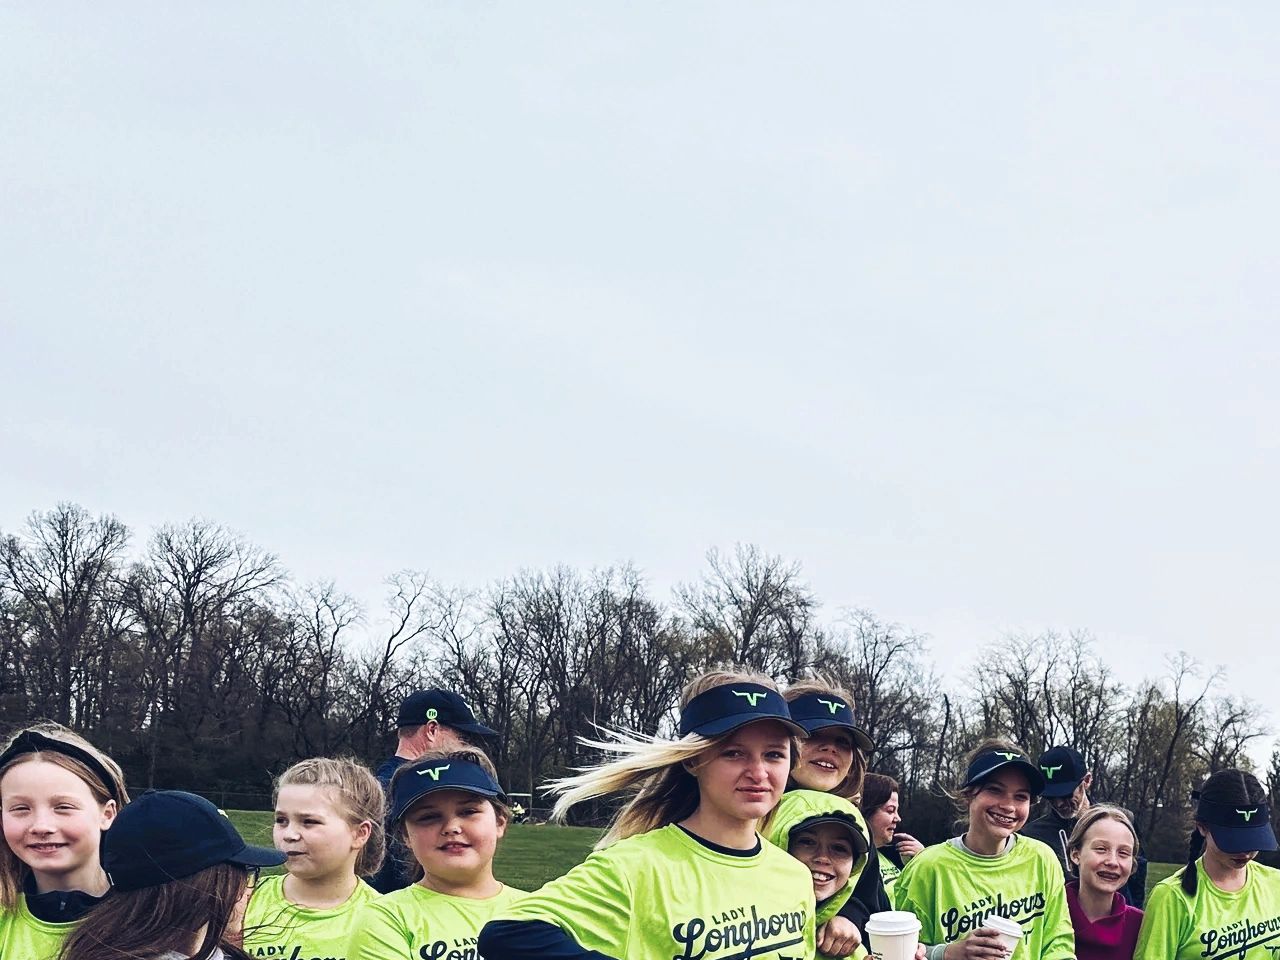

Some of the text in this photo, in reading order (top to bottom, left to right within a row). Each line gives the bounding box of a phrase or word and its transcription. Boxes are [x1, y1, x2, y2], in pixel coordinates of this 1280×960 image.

[963, 895, 992, 912] LADY
[711, 906, 746, 925] LADY
[1221, 920, 1243, 934] LADY
